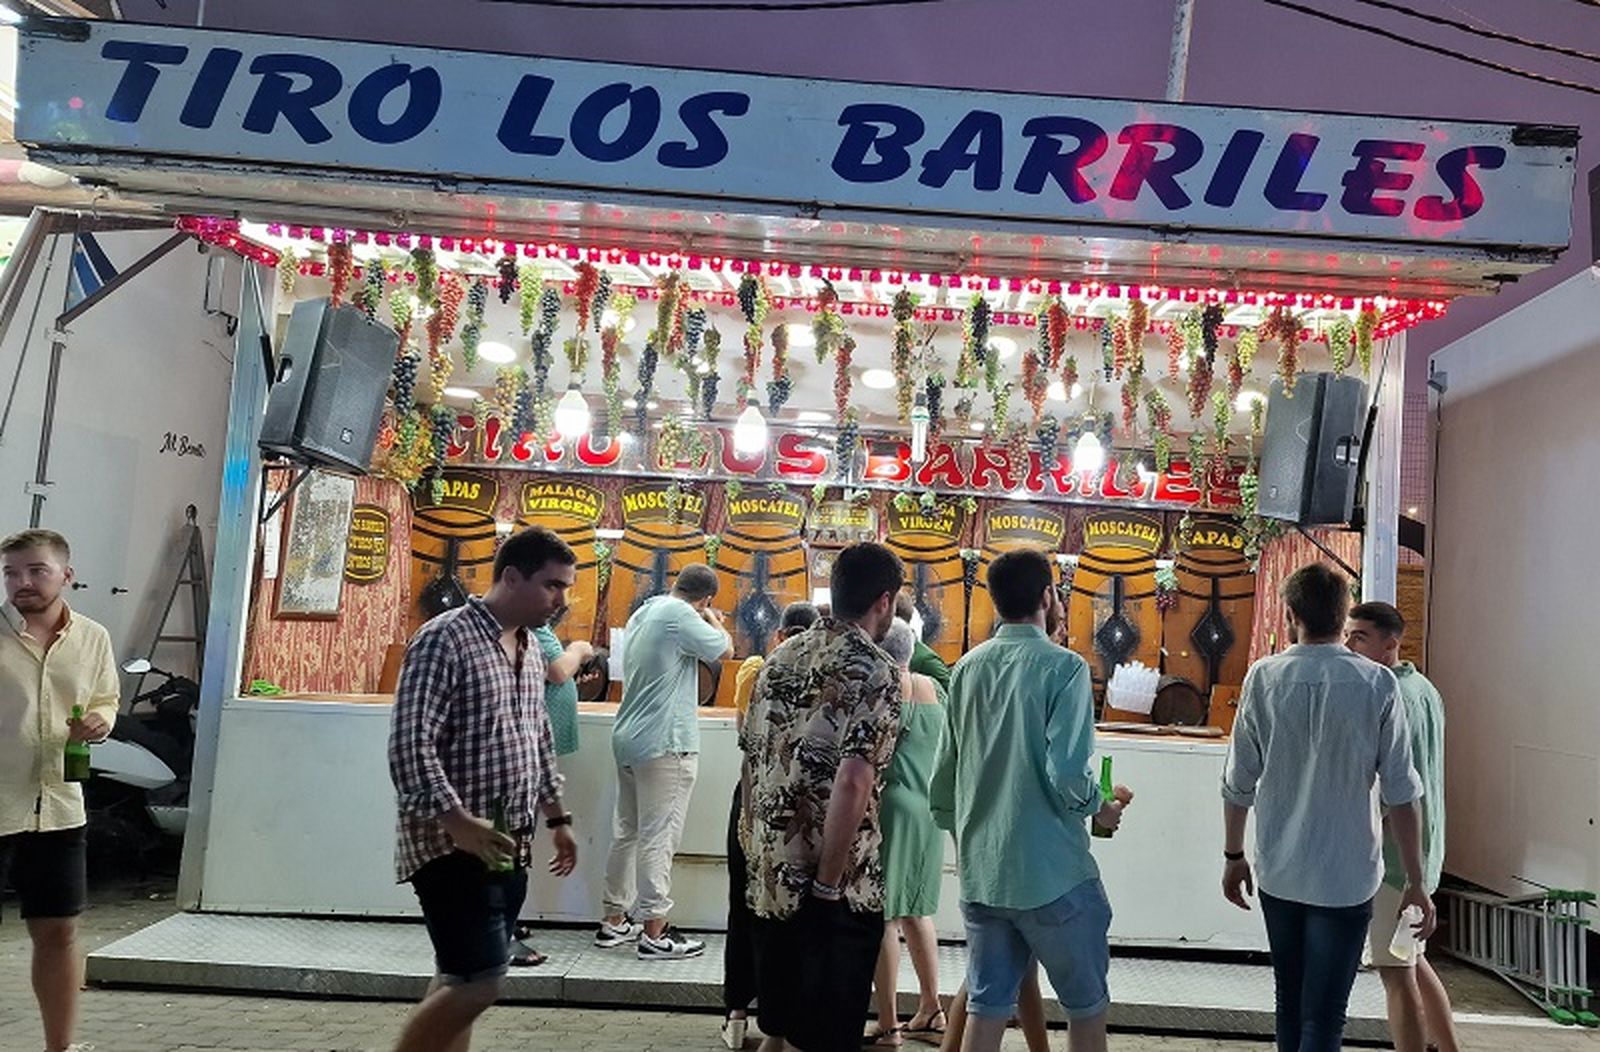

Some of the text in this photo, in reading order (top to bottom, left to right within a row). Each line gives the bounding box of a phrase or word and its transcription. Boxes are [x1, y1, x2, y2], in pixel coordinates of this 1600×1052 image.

[101, 39, 1507, 222] TIRO LOS BARRILES
[440, 479, 482, 500] APAS
[528, 498, 597, 518] VIRGEN
[623, 490, 702, 514] MOSCTEL
[728, 498, 800, 518] MOSCATEL
[900, 500, 957, 518] AGA
[898, 515, 954, 533] VIRGEN
[990, 515, 1060, 537] MOSCATEL
[1087, 520, 1159, 543] MOSCATEL
[1190, 530, 1245, 549] APAS
